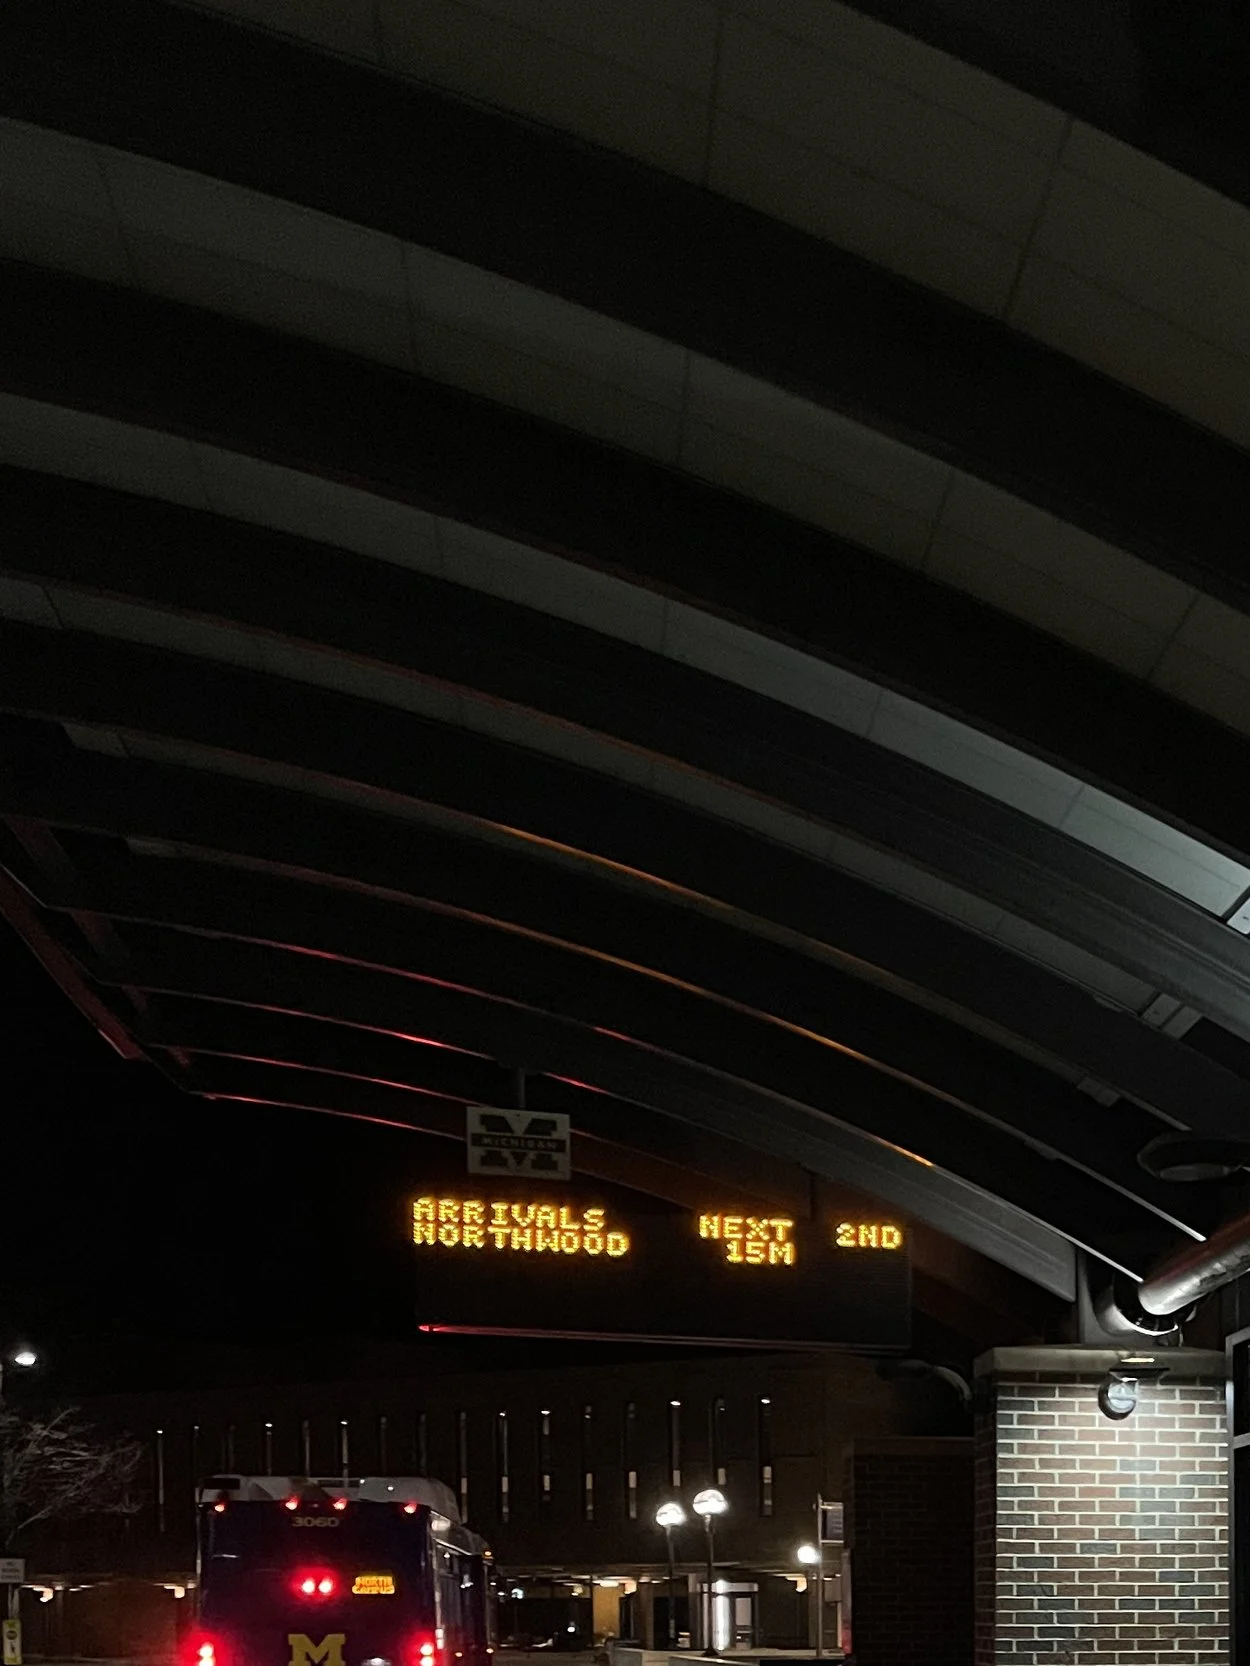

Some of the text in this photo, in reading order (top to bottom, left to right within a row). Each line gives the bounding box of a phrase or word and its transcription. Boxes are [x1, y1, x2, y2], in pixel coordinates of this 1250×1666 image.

[480, 1137, 557, 1150] MICHIGAN
[413, 1197, 901, 1249] ARRIVALS NEXT 2ND
[413, 1221, 794, 1266] NORTHWOOD 15M
[355, 1576, 393, 1586] NORTH
